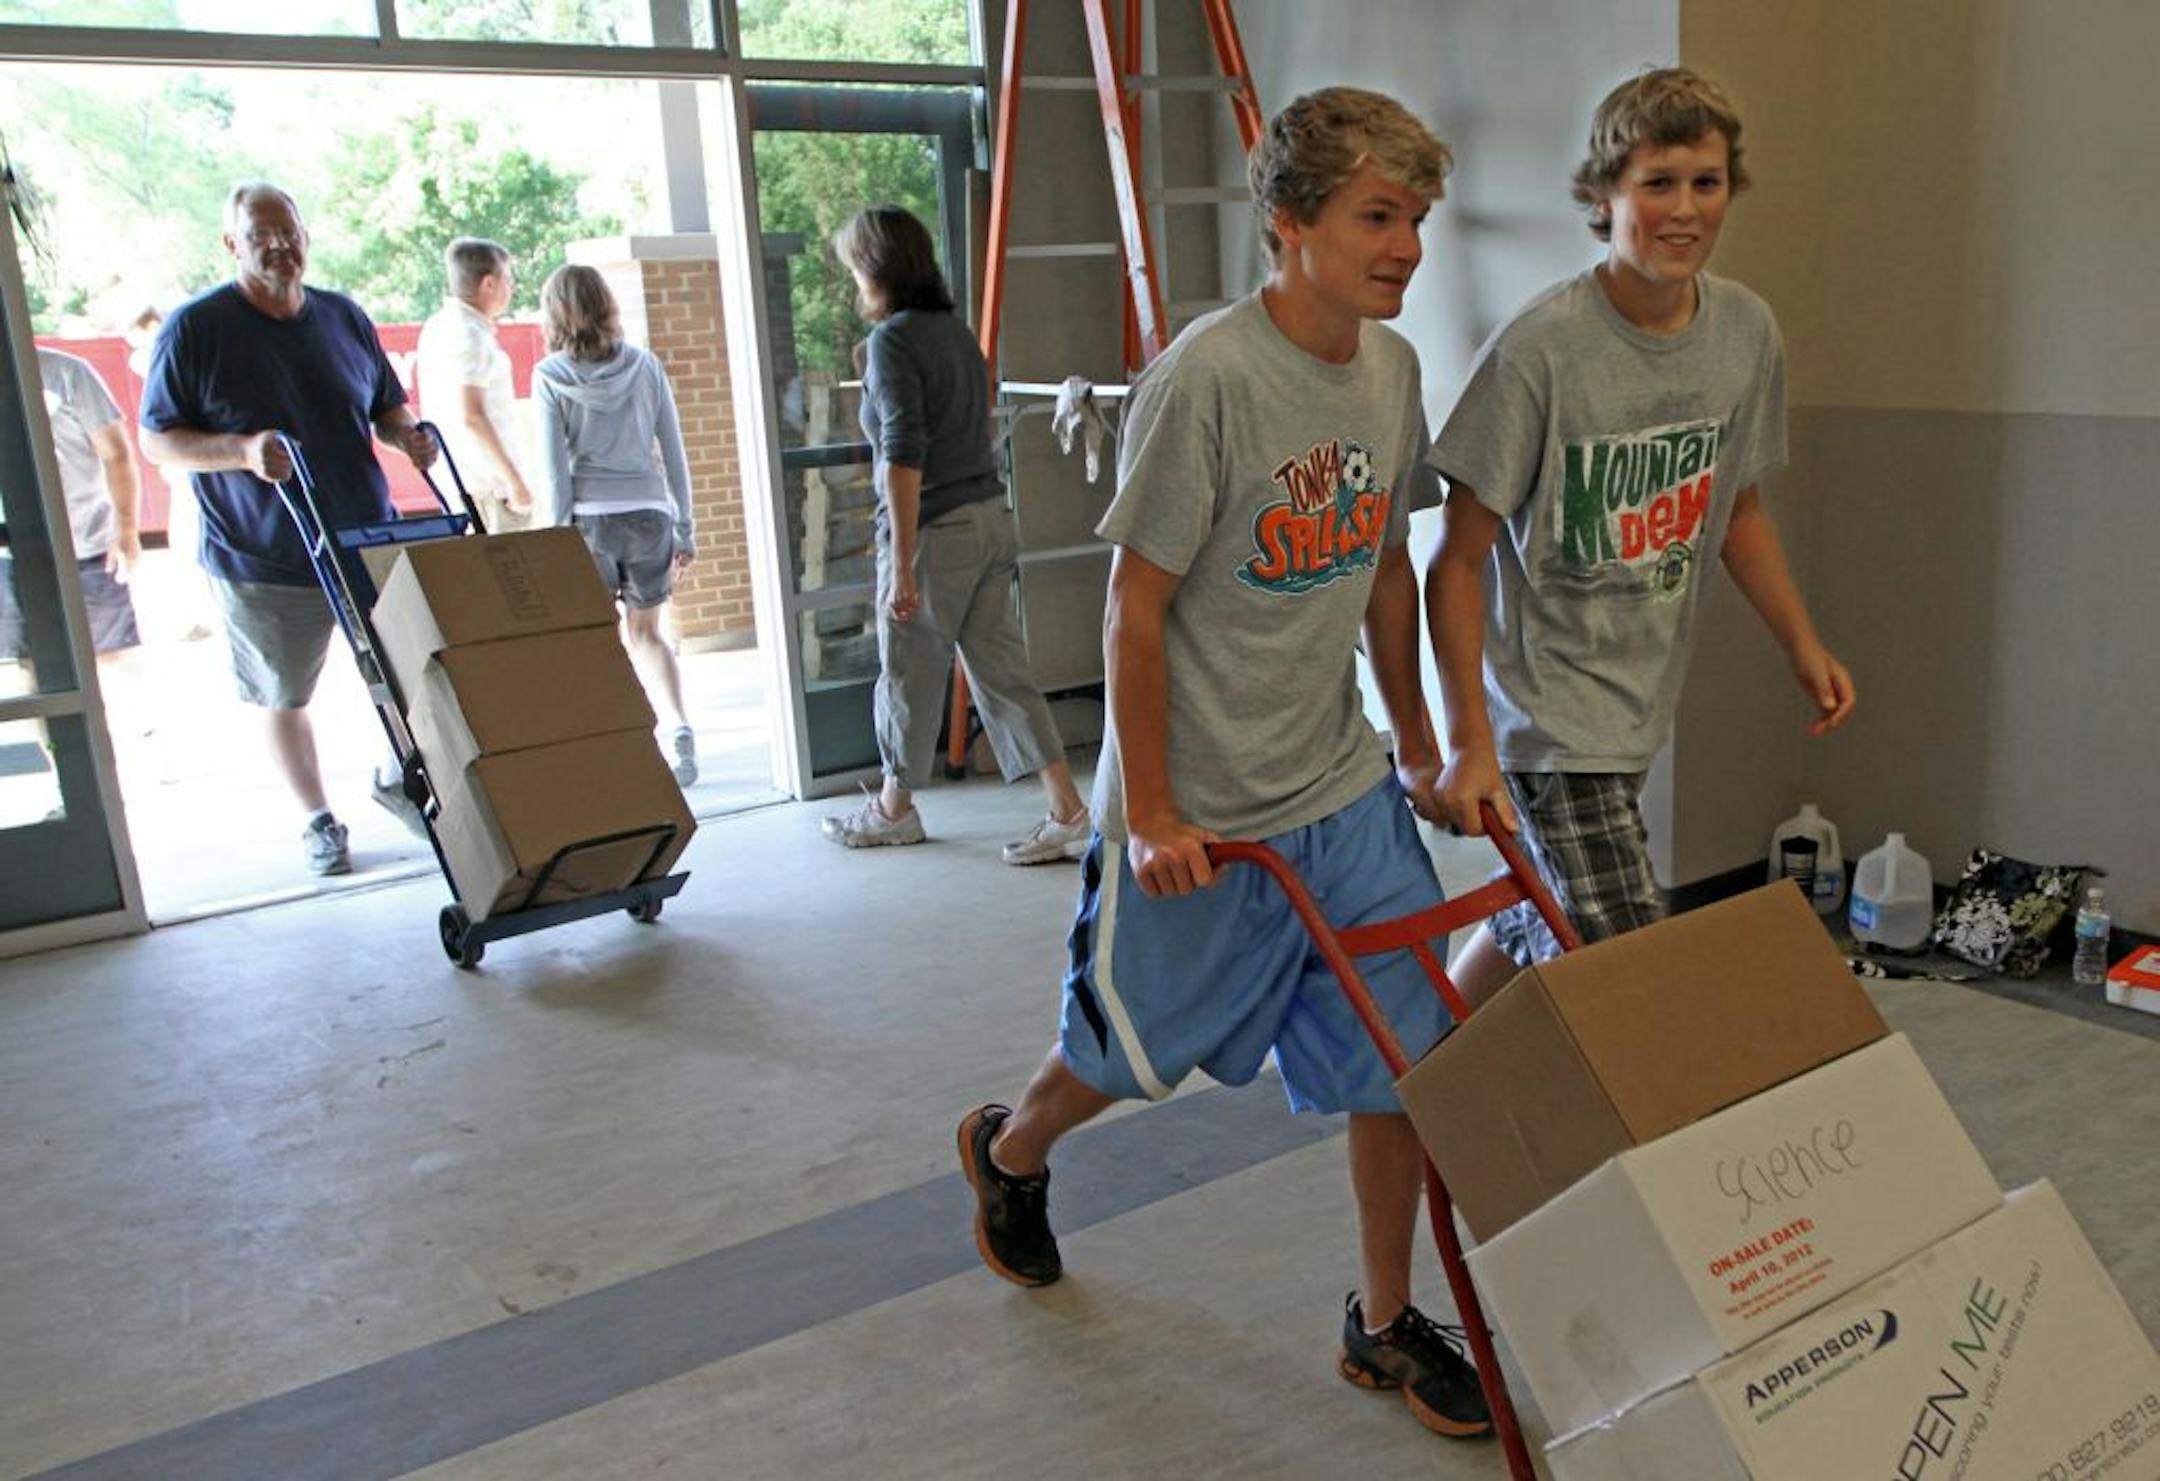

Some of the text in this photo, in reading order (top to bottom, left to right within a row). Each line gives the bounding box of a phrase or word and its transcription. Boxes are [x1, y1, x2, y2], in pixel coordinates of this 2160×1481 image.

[1272, 439, 1342, 513] TONKA
[1771, 1216, 1815, 1246] DATE:
[1729, 1271, 1761, 1295] April
[1745, 1318, 1875, 1409] APPERSON
[1894, 1276, 2008, 1481] PEN ME
